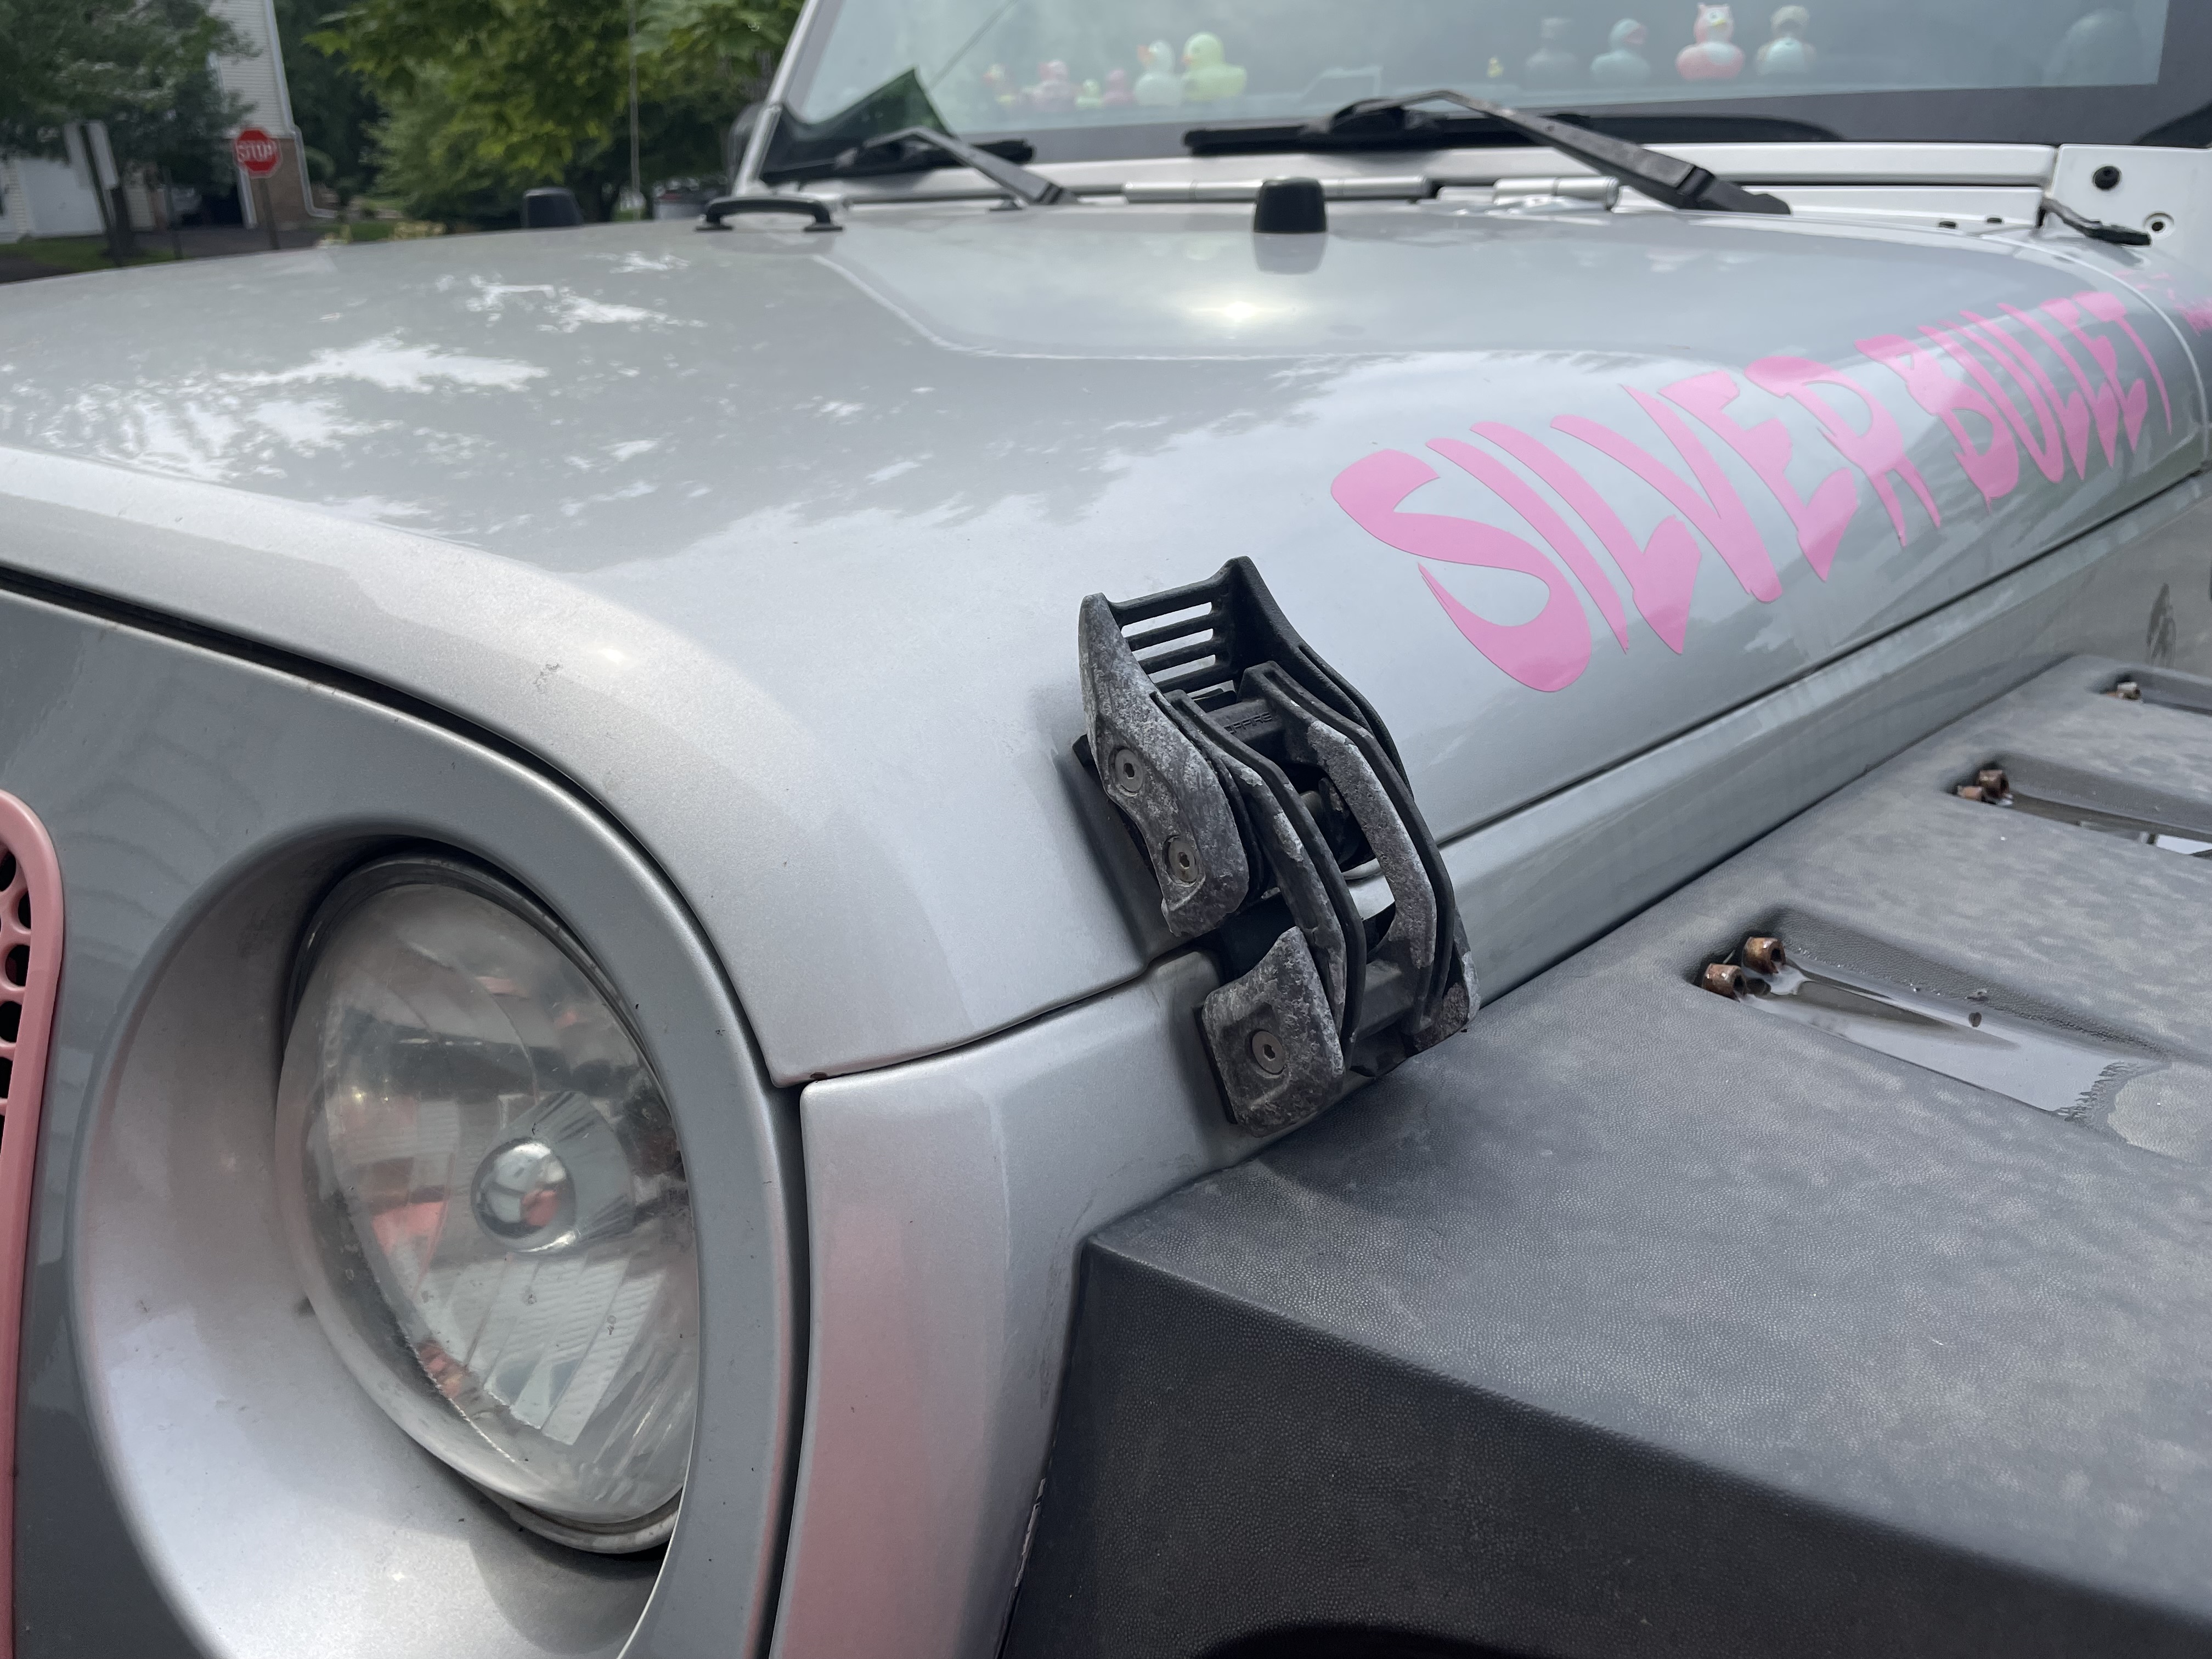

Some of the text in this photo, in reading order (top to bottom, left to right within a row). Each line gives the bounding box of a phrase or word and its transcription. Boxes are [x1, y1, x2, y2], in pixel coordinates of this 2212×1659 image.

[236, 140, 277, 162] STOP
[1330, 291, 2171, 692] SILVER BULLET
